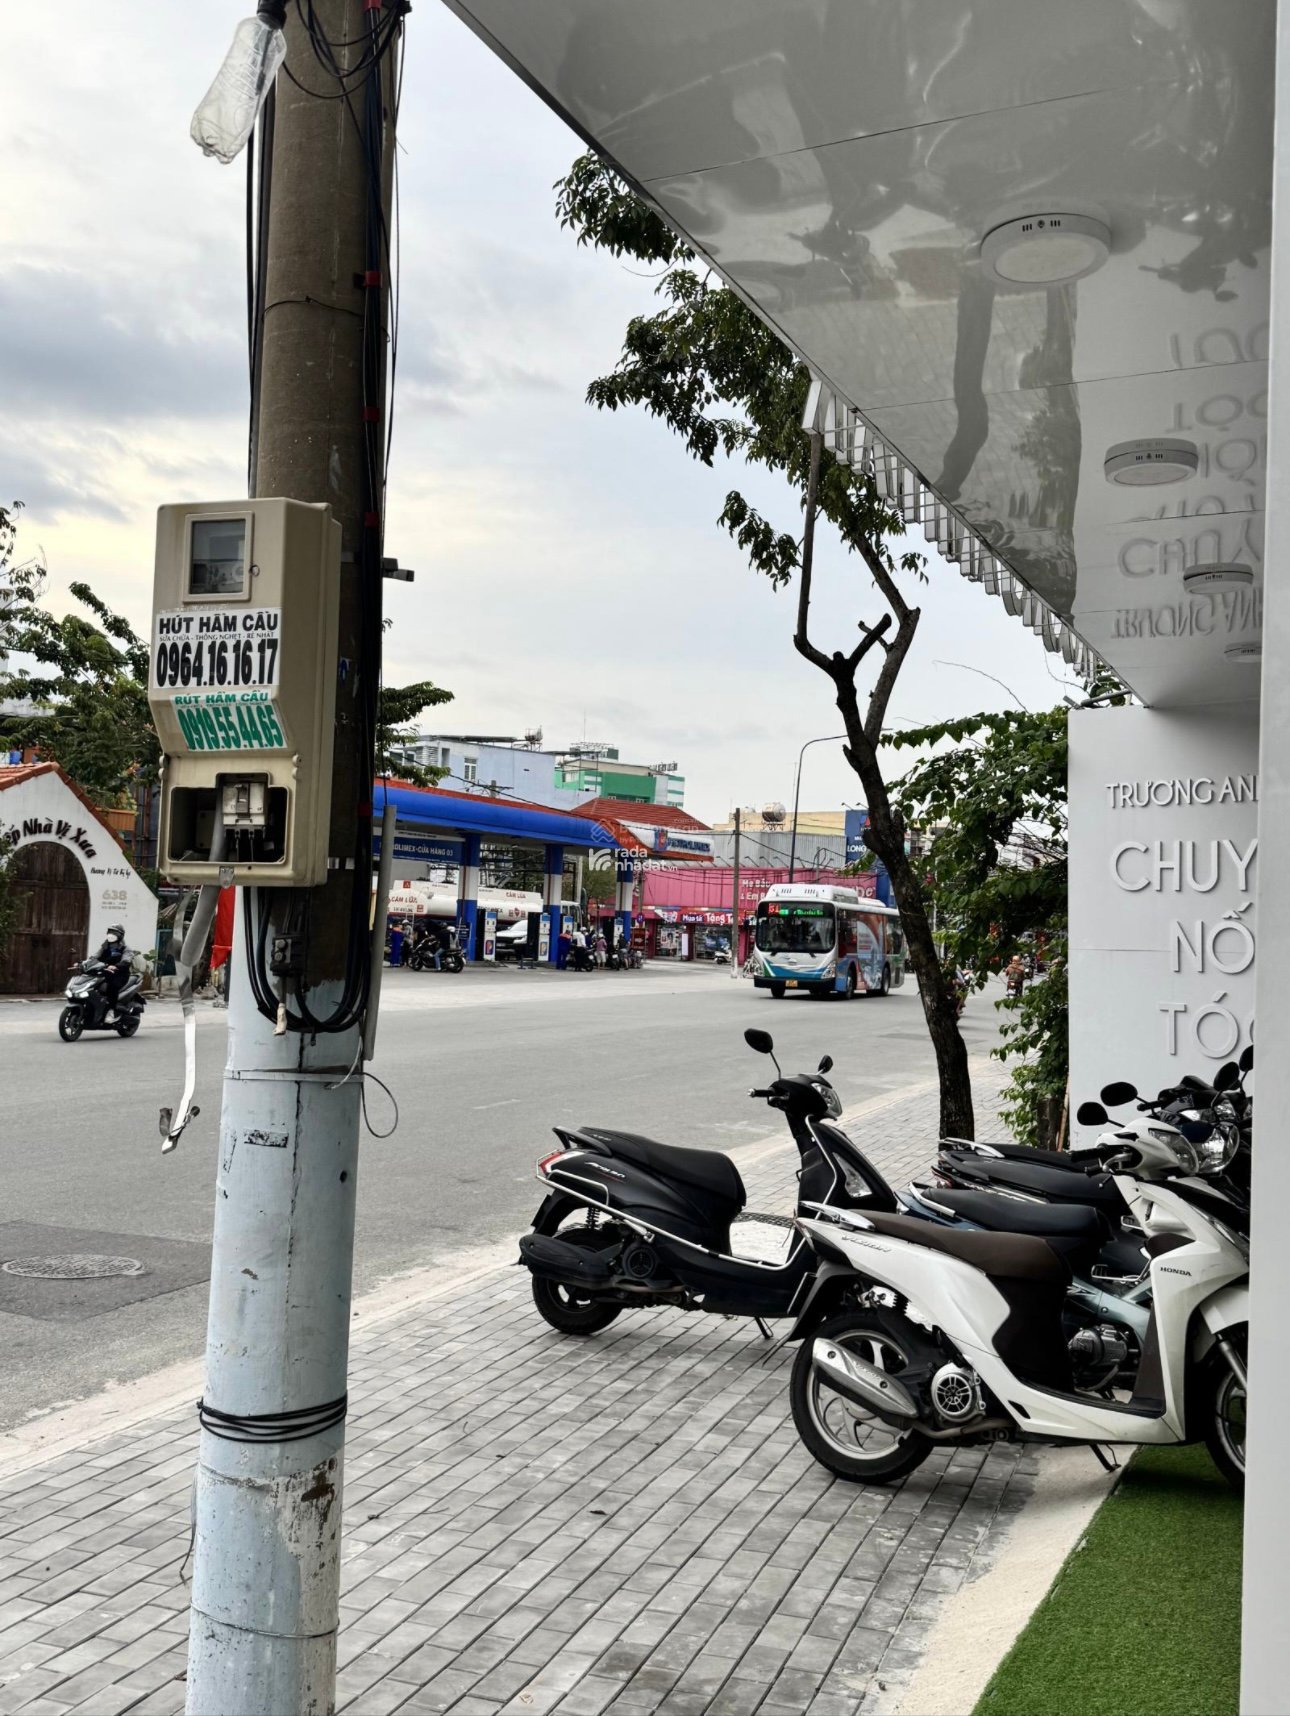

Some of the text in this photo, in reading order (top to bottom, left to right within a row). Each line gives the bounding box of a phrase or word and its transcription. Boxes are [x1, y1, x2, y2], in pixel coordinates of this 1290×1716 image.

[158, 614, 194, 634] HÚT
[199, 612, 237, 633] HẦM
[242, 610, 278, 632] CẦU
[156, 638, 278, 687] 0964.16.16.17
[174, 689, 268, 705] RÚT HẦM CẦU
[177, 704, 284, 750] 0919.55.44.65
[1105, 777, 1214, 808] TRƯƠNG
[22, 816, 54, 837] Nhà
[55, 819, 72, 839] Vị
[69, 827, 97, 859] Xưa
[102, 890, 127, 901] 638
[1158, 991, 1254, 1059] TÓ
[1160, 1266, 1192, 1277] HONDA
